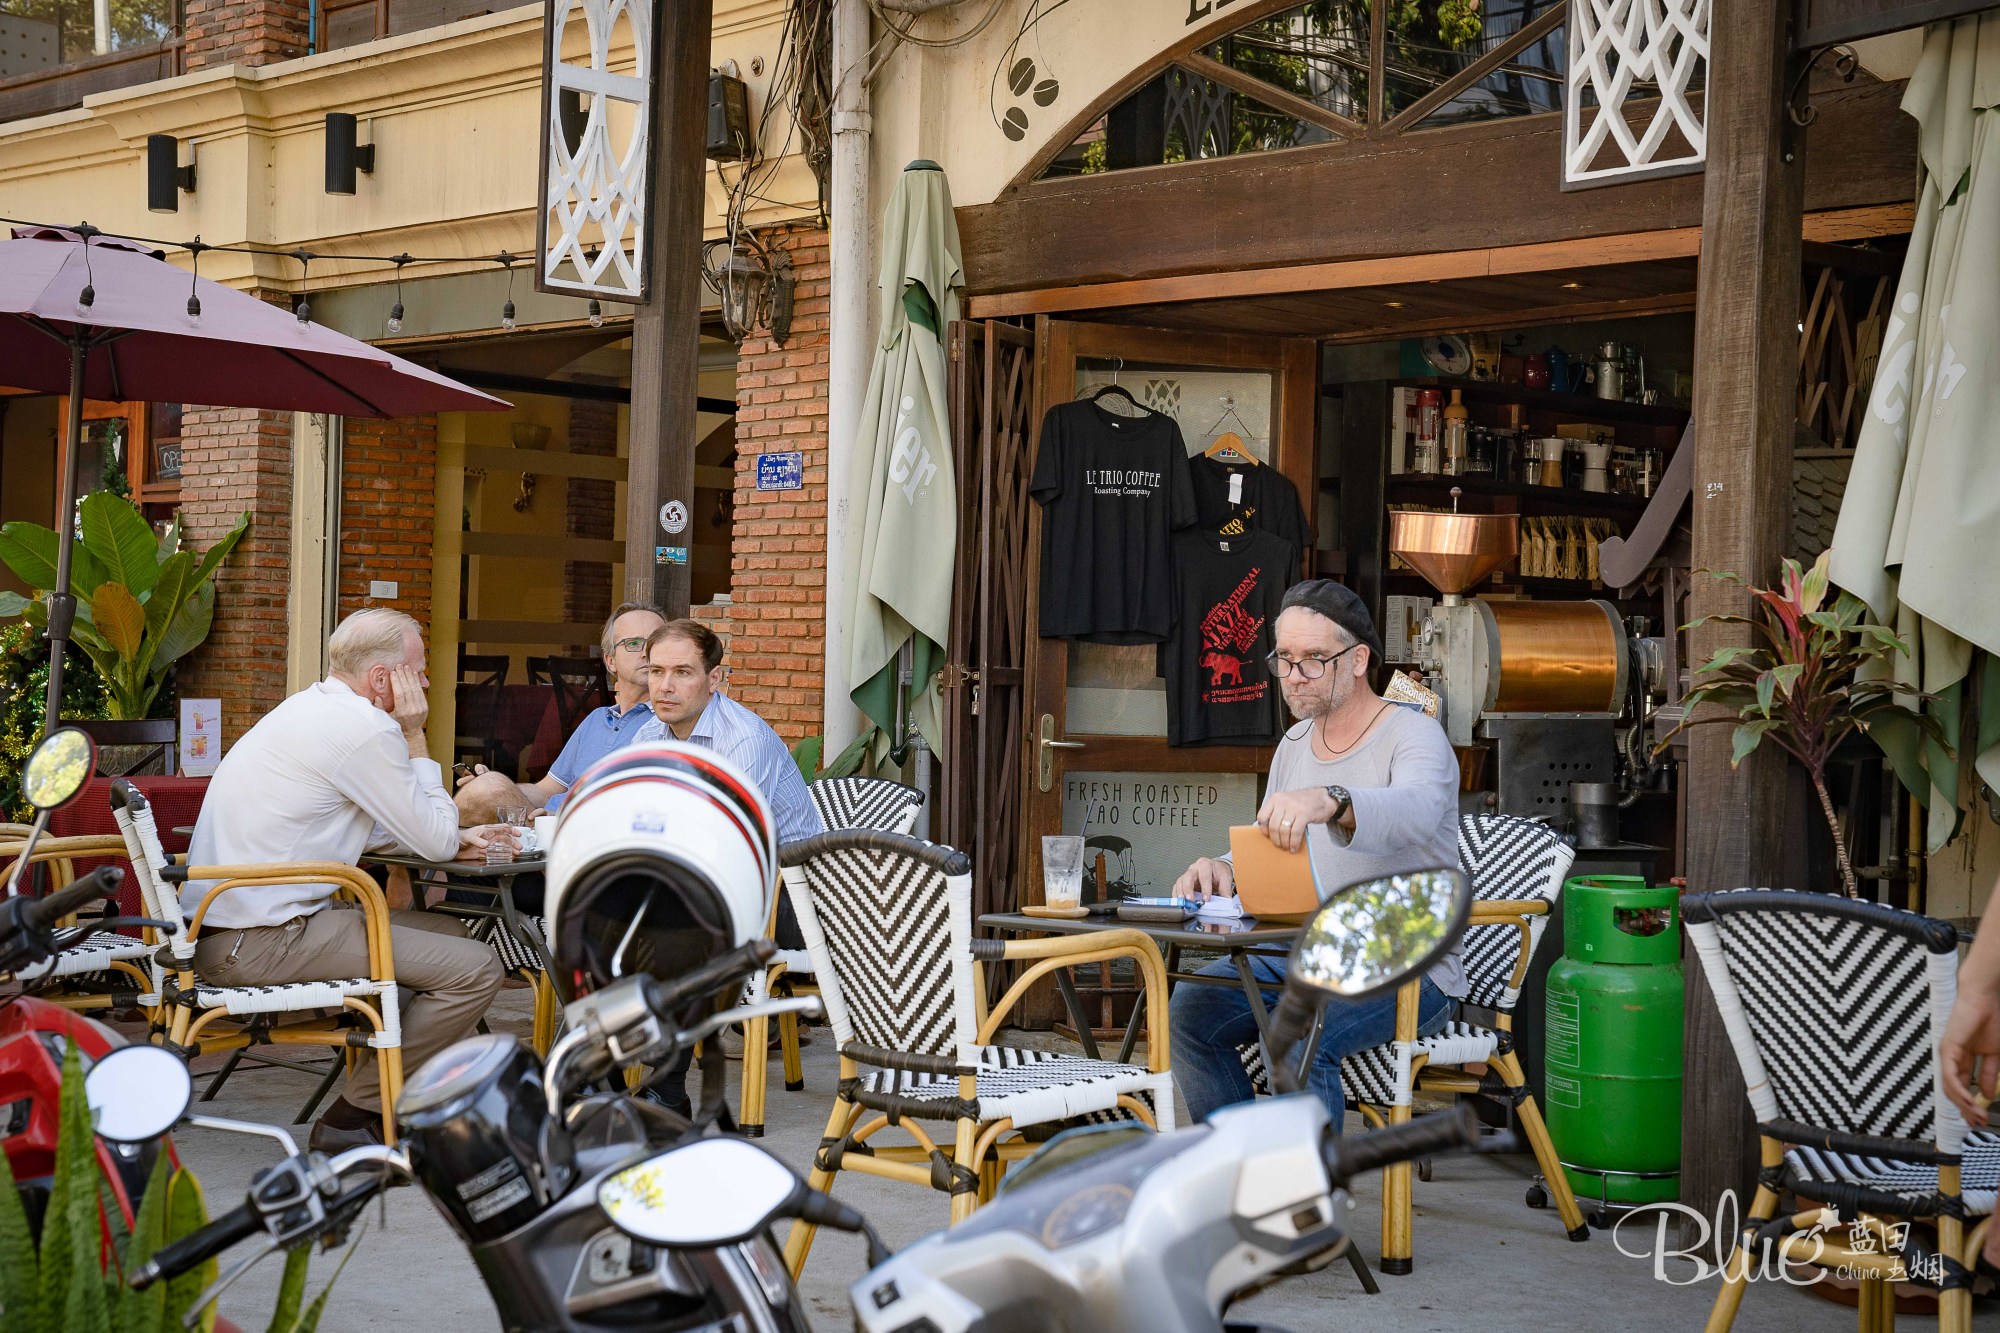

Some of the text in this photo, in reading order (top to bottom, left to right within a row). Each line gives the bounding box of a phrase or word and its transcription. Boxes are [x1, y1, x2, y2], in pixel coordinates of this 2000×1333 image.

[163, 450, 182, 469] OPE
[1086, 470, 1161, 488] LE TRIO COFFEE
[1094, 486, 1151, 498] Roasting Company
[1203, 567, 1260, 636] INTERNATIONAL
[1237, 580, 1257, 604] FESTIVAL
[1209, 601, 1242, 646] JAZZ
[1217, 608, 1250, 650] VIENTIANE
[1233, 617, 1255, 647] 2019
[1068, 781, 1218, 805] FRESH ROASTED
[1086, 804, 1199, 827] LAO COFFEE
